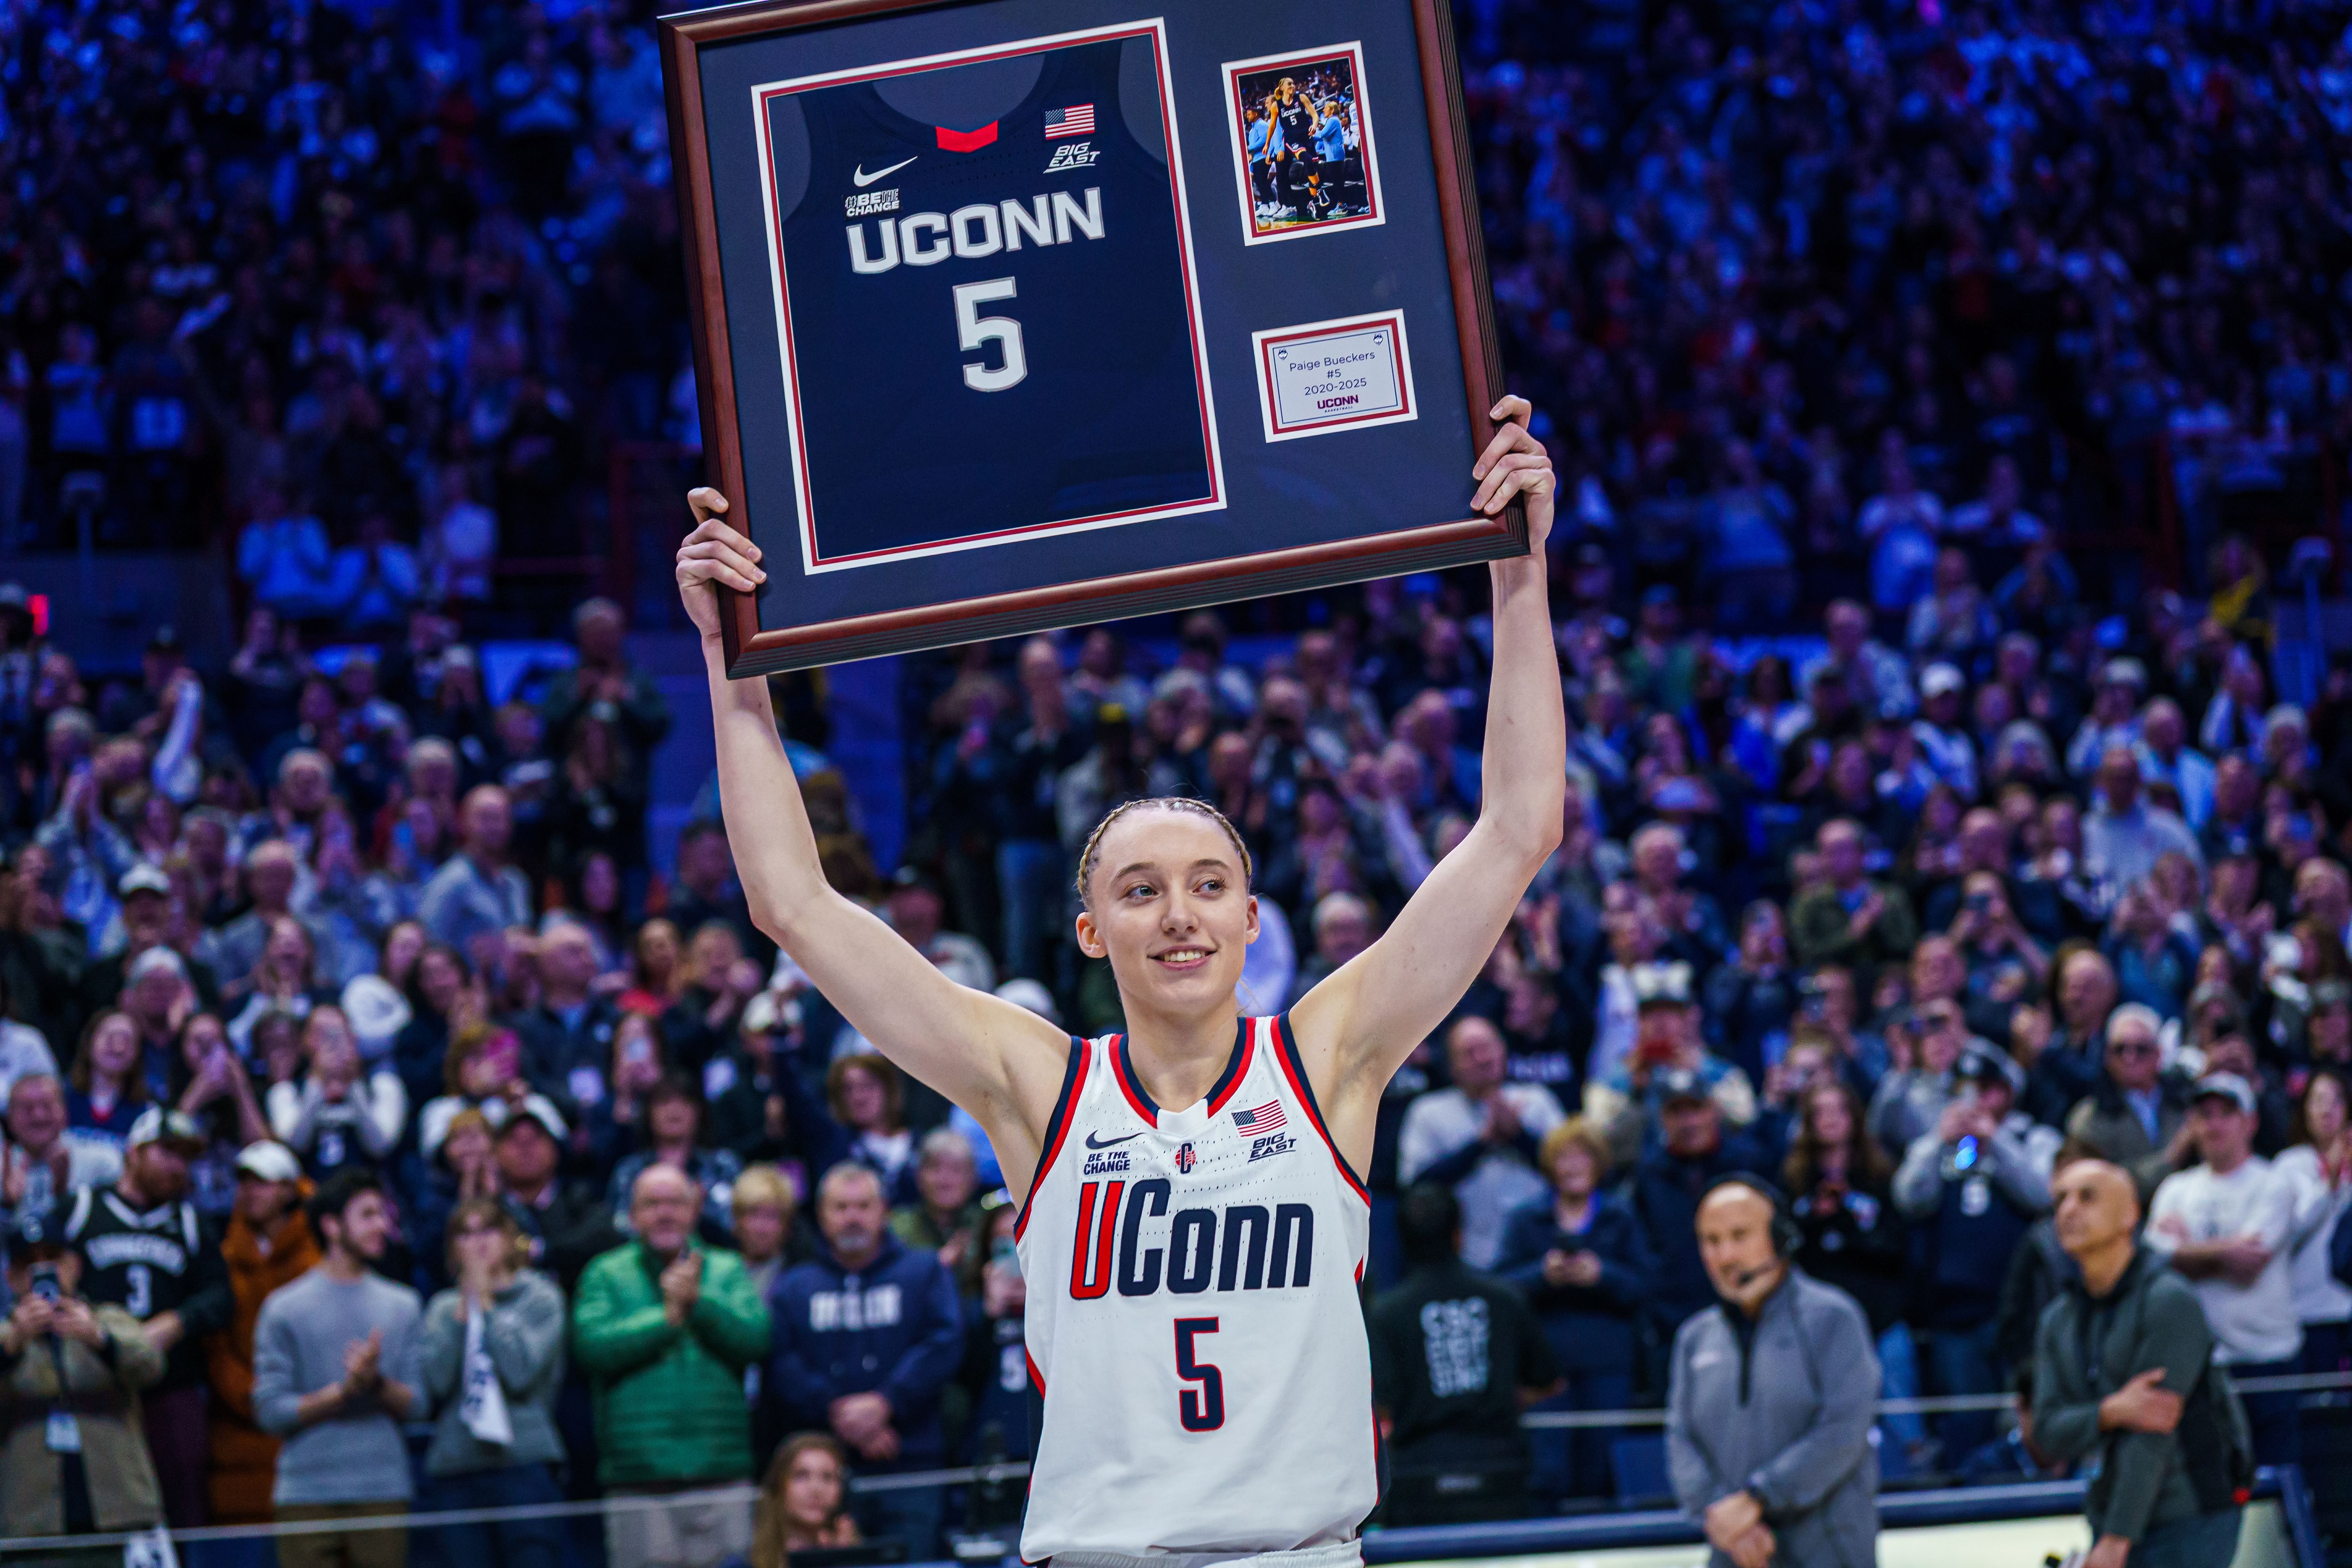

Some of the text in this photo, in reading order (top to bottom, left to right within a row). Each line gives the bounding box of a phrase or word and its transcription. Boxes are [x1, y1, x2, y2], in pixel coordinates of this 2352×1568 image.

[1290, 115, 1297, 125] 5
[1054, 141, 1091, 156] BIG
[1049, 151, 1101, 168] EAST
[847, 200, 900, 217] CHANGE
[846, 187, 1105, 274] UCONN
[952, 276, 1027, 393] 5
[1290, 351, 1375, 372] Paige Bueckers
[1326, 369, 1341, 379] #5
[1304, 377, 1367, 396] 2020-2025
[1317, 394, 1359, 409] UCONN
[1249, 1138, 1297, 1158] EAST
[1253, 1132, 1285, 1149] BIG
[1088, 1151, 1130, 1162] BE THE
[1083, 1159, 1131, 1175] CHANGE
[126, 1264, 152, 1317] 3
[1174, 1316, 1225, 1432] 5
